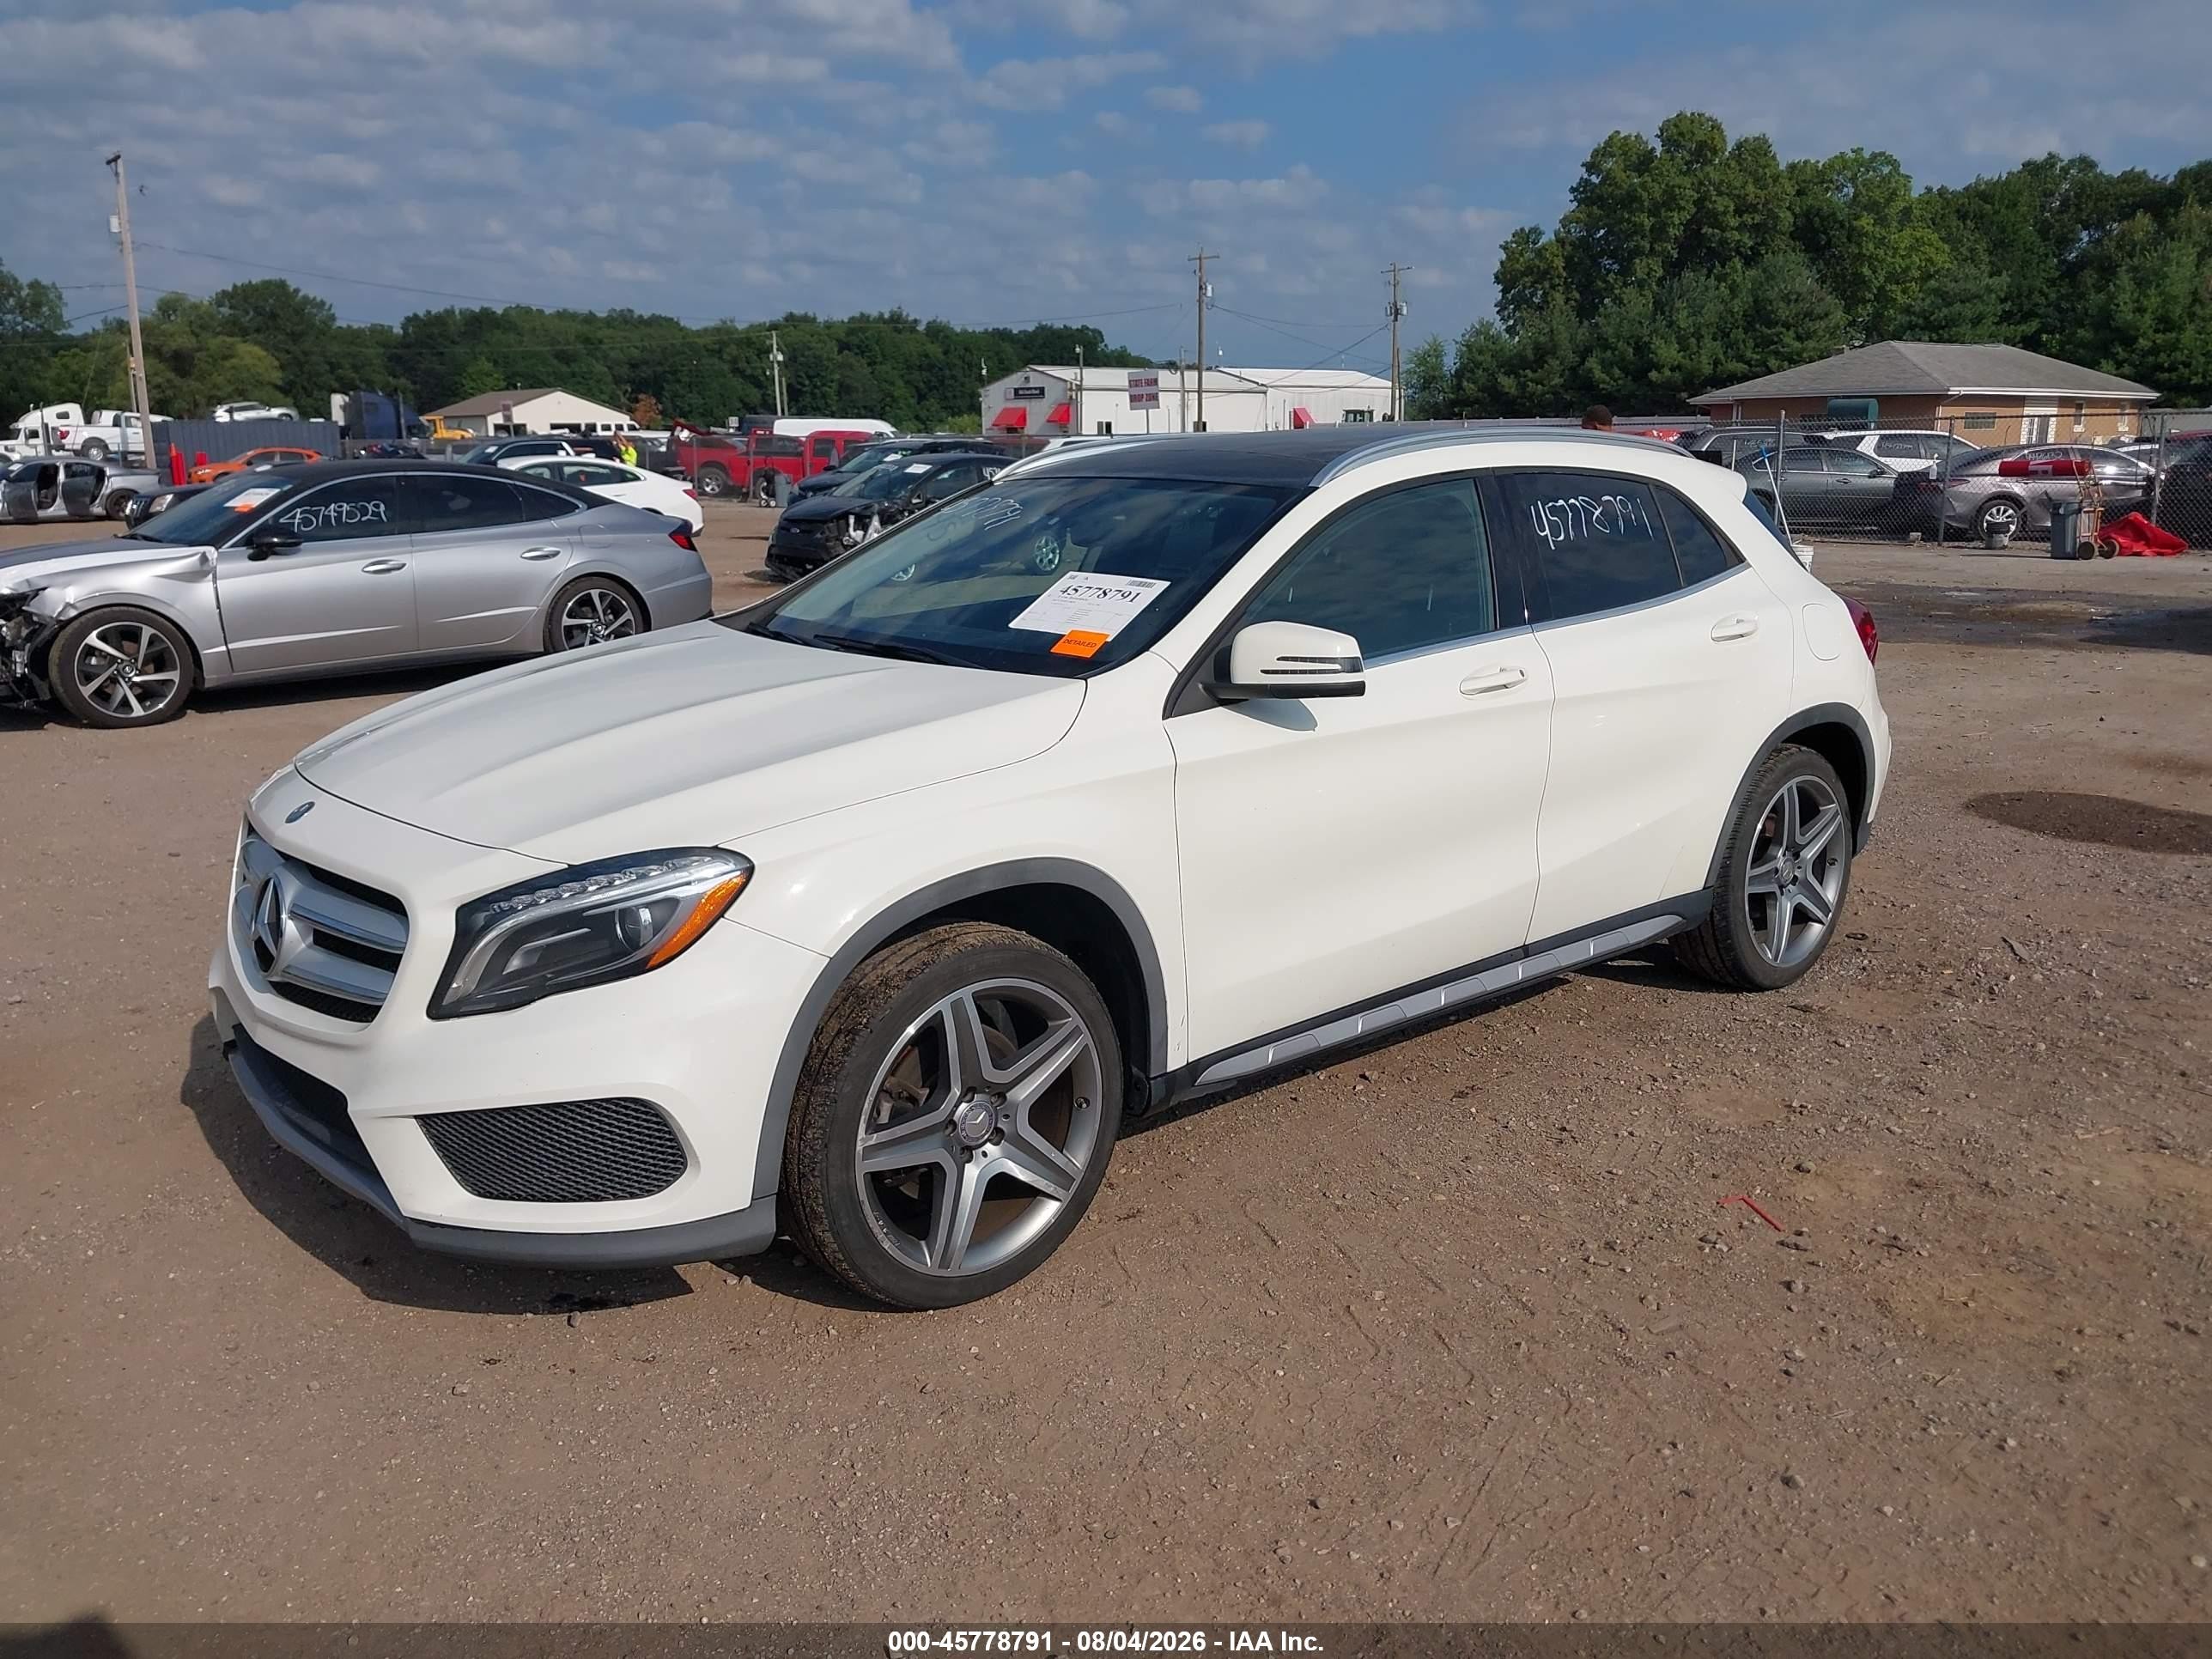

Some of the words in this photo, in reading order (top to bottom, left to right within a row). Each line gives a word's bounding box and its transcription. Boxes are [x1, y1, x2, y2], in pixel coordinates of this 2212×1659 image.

[279, 501, 388, 532] 45749529
[1529, 495, 1655, 550] 45778791
[1060, 584, 1142, 604] 45778791
[1063, 638, 1097, 648] DETAILED
